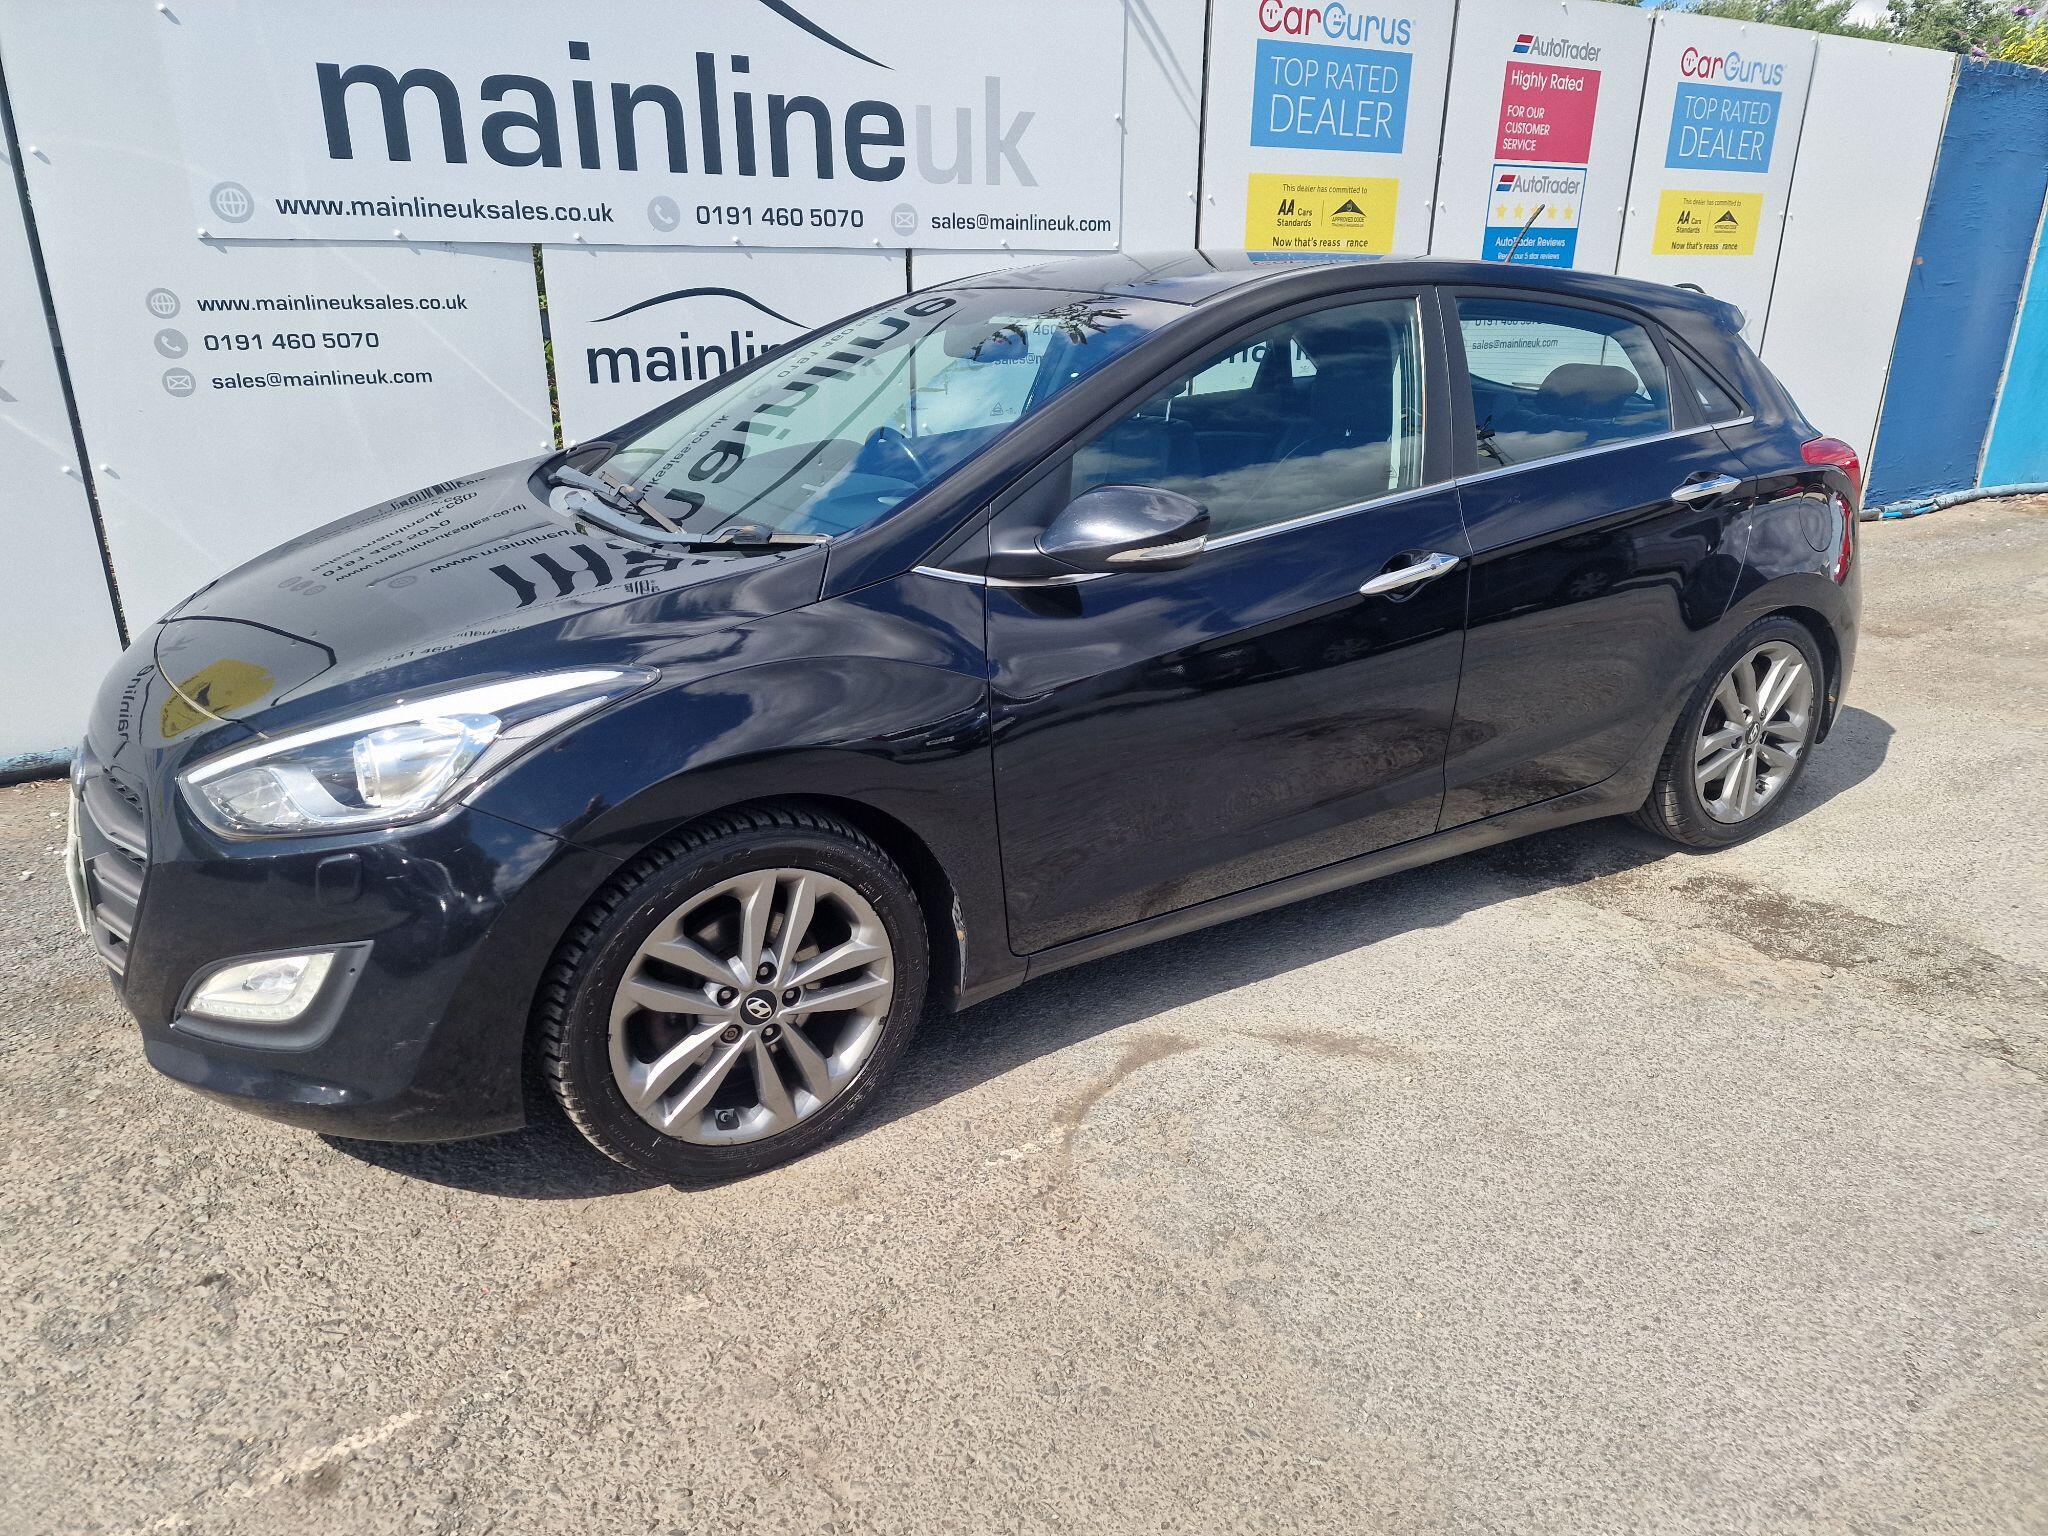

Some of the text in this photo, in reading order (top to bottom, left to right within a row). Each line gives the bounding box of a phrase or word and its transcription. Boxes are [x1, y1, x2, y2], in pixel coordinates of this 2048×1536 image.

[1259, 0, 1411, 45] CarGurus
[1530, 36, 1601, 61] AutoTrader
[1271, 56, 1398, 94] TOP RATED
[1681, 47, 1784, 85] CarGurus
[1511, 70, 1584, 91] Highly Rated
[1270, 94, 1392, 138] DEALER
[1507, 105, 1545, 118] FOR OUR
[1685, 96, 1771, 125] TOP RATED
[1505, 122, 1550, 135] CUSTOMER
[1502, 138, 1537, 151] SERVICE
[1679, 126, 1764, 161] DEALER
[1283, 184, 1295, 192] This
[1297, 184, 1316, 192] dealer
[1316, 185, 1328, 193] has
[1329, 186, 1360, 194] committed
[1512, 175, 1580, 194] AutoTrader
[275, 196, 614, 223] www.mainlineuksales.co.uk
[696, 205, 864, 228] 0191 460 5070
[1278, 199, 1313, 216] AA Cars
[1677, 210, 1691, 224] AA
[931, 213, 1112, 232] sales@mainlineuk.com
[1277, 219, 1312, 227] Standards
[1676, 226, 1700, 234] Standards
[1272, 237, 1292, 247] Now
[1294, 236, 1318, 247] that's
[1495, 236, 1566, 247] AutoTader Reviews
[1671, 242, 1685, 250] Now
[1686, 241, 1703, 250] that's
[197, 295, 469, 312] www.mainlineuksales.co.uk
[203, 331, 380, 351] 0191 460 5070
[1472, 338, 1559, 350] sales@mainlineuk.com
[212, 369, 433, 389] sales@mainlineuk.com
